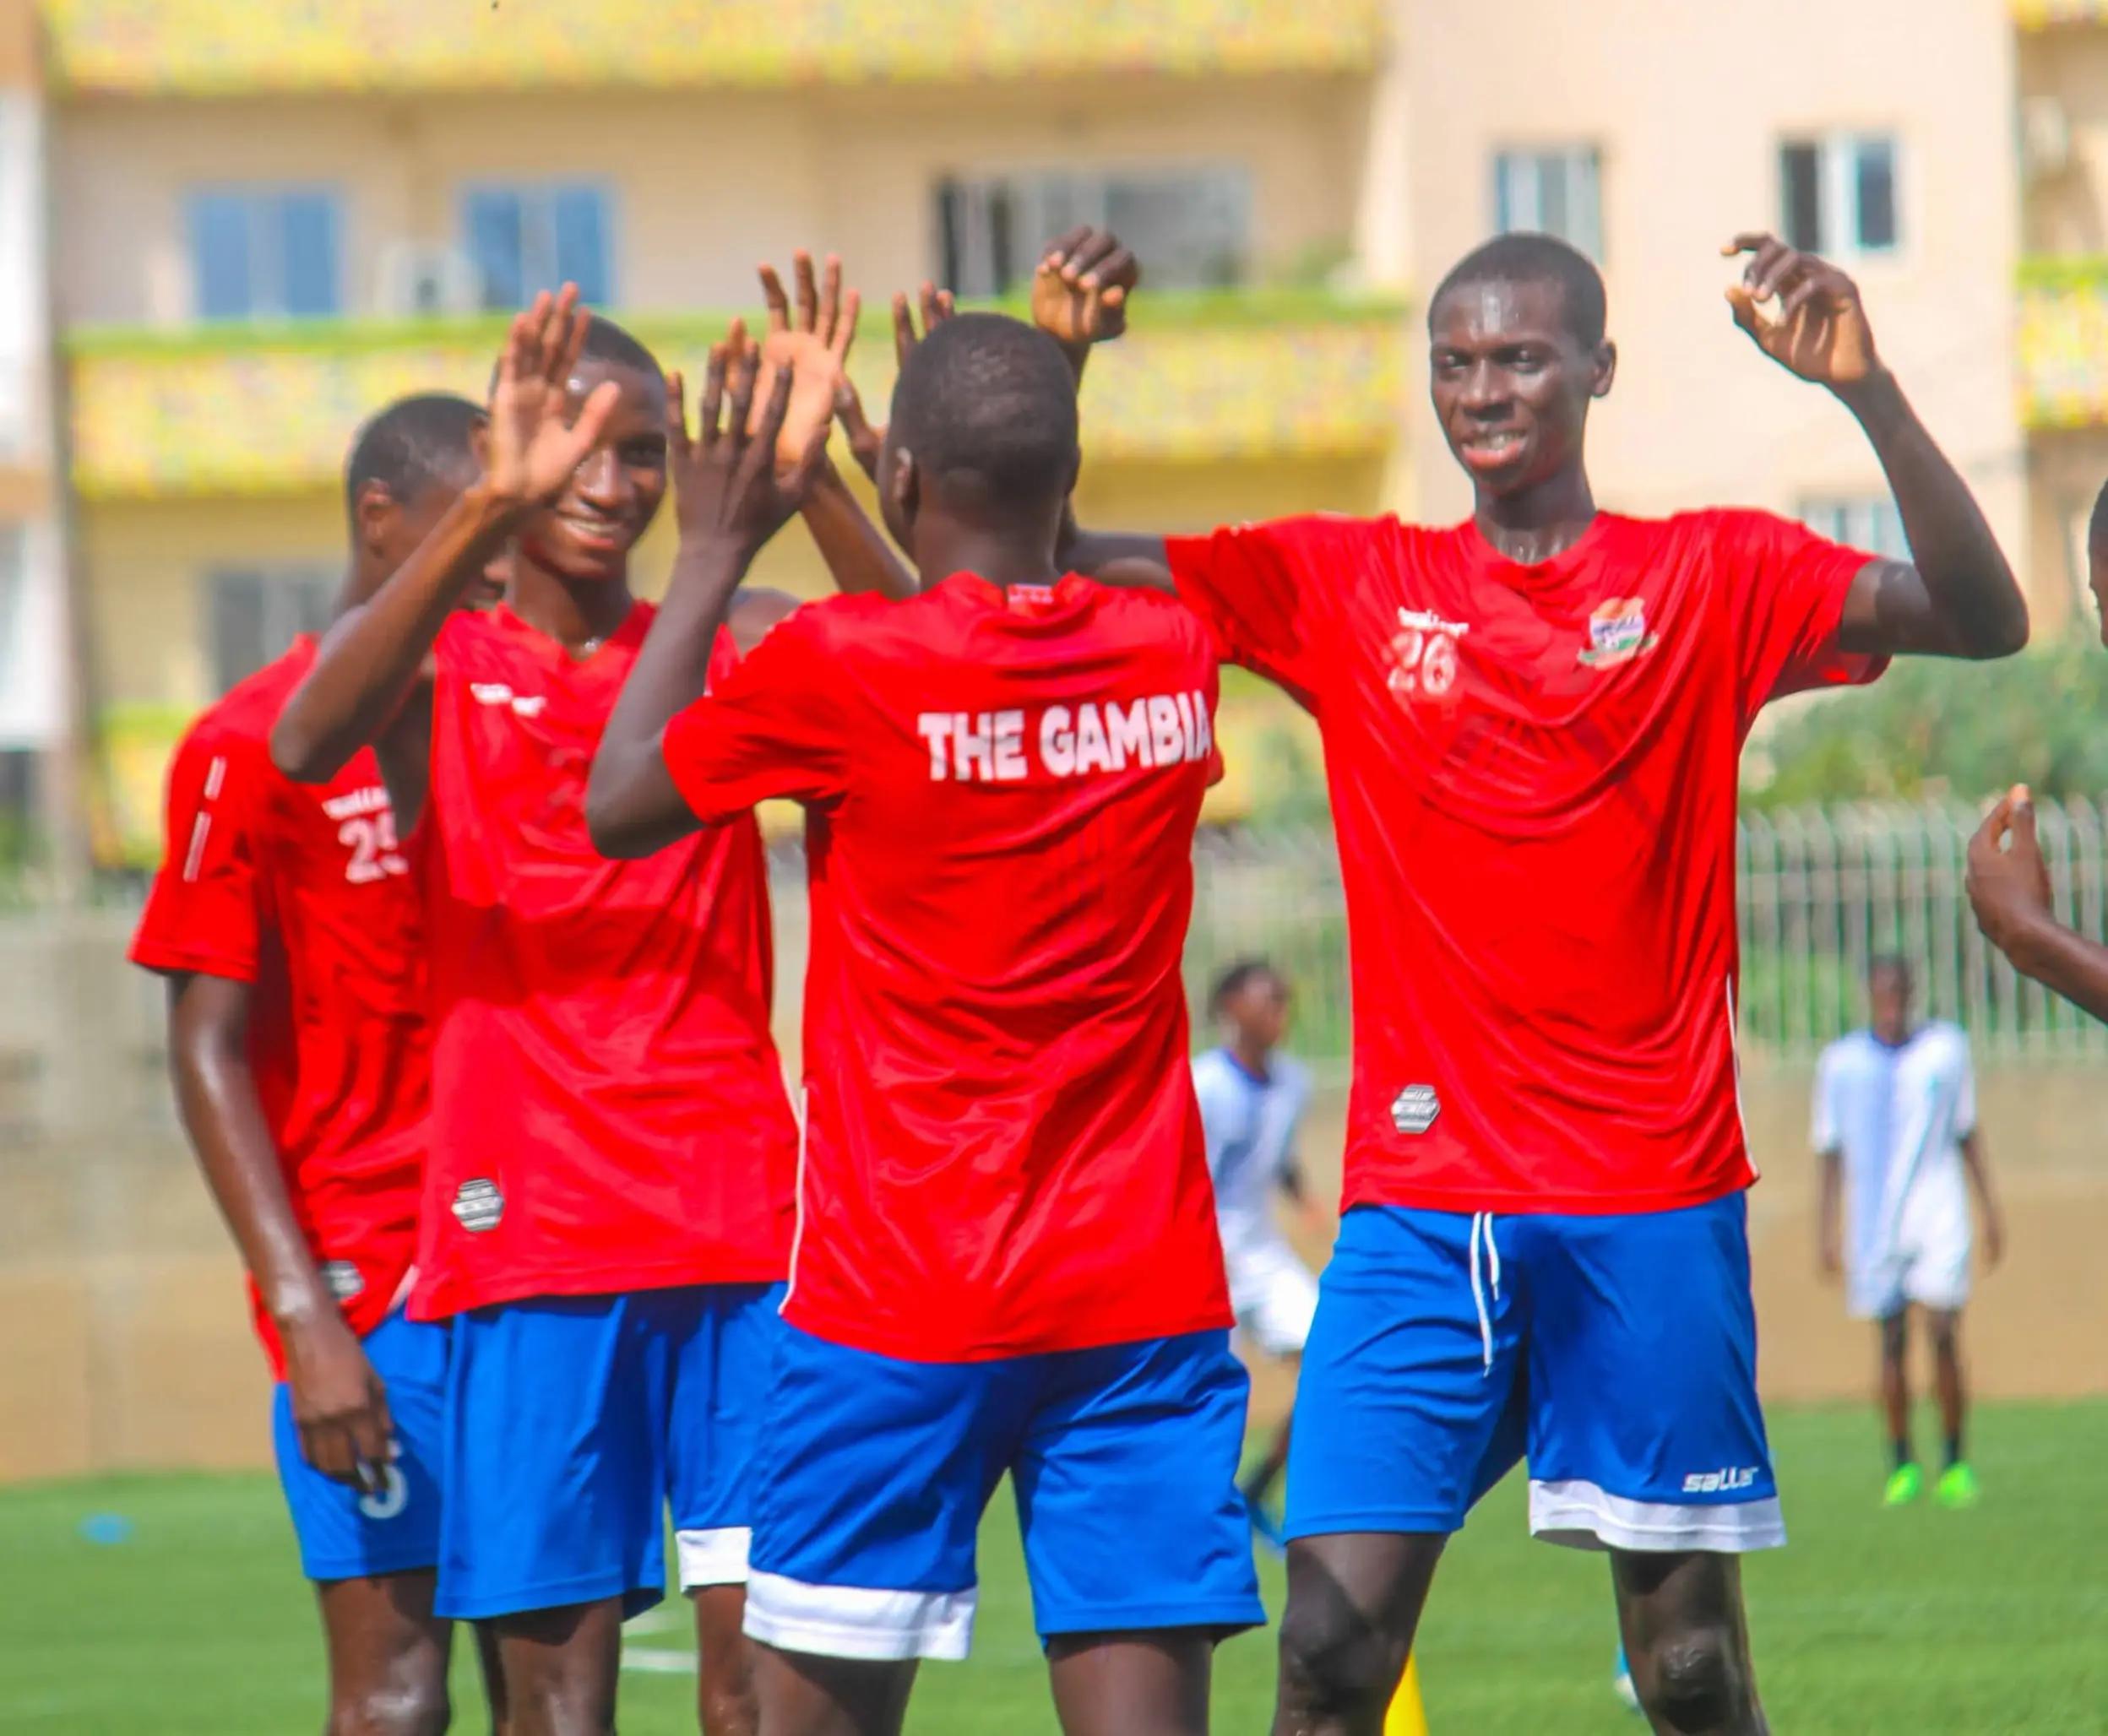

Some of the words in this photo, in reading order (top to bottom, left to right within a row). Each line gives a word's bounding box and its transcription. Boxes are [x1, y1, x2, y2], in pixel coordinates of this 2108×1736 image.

[1383, 631, 1457, 695] 26
[917, 709, 1028, 782] THE
[1039, 689, 1213, 778] GAMBIA
